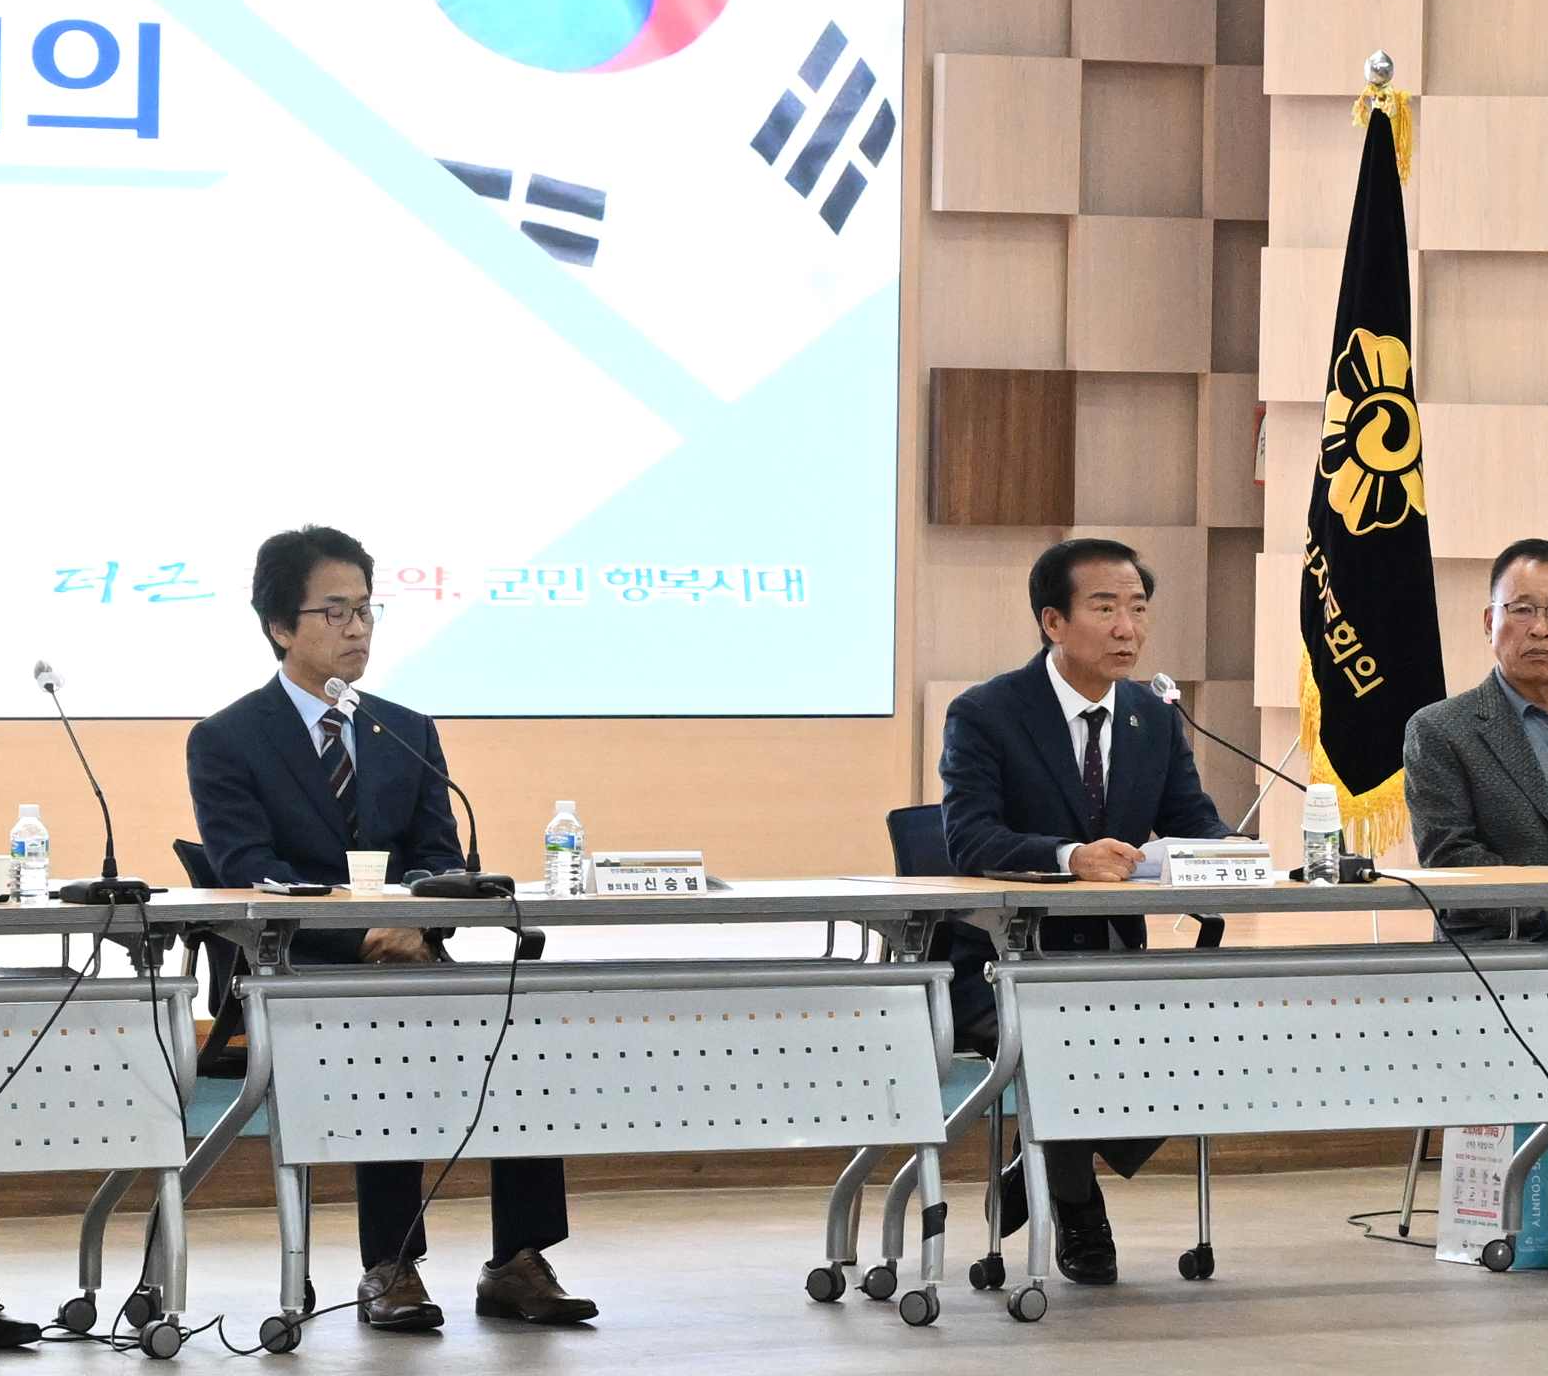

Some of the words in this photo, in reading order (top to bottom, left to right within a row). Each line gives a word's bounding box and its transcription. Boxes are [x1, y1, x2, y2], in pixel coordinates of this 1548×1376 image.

[54, 561, 119, 604] 더
[484, 567, 585, 602] 군민
[604, 567, 806, 603] 행복시대
[1178, 874, 1207, 882] 거창군수
[1531, 1175, 1541, 1228] COUNTY
